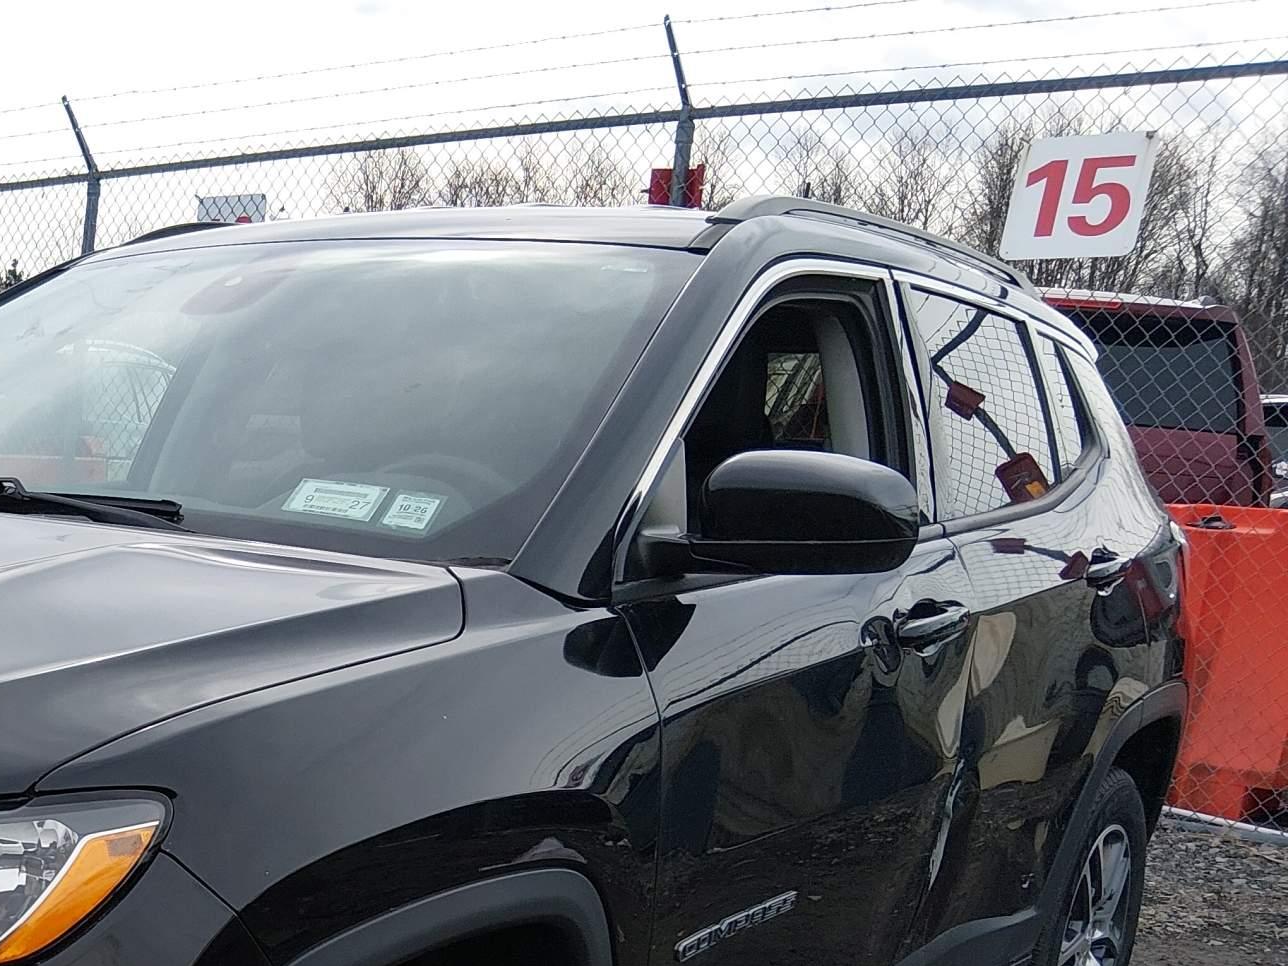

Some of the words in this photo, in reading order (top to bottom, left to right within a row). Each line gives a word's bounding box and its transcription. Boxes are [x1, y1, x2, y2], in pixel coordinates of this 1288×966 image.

[1026, 155, 1136, 237] 15
[304, 494, 314, 504] 9
[349, 500, 371, 511] 27
[398, 503, 410, 512] 10
[413, 504, 429, 514] 26
[674, 889, 798, 963] COMPASS
